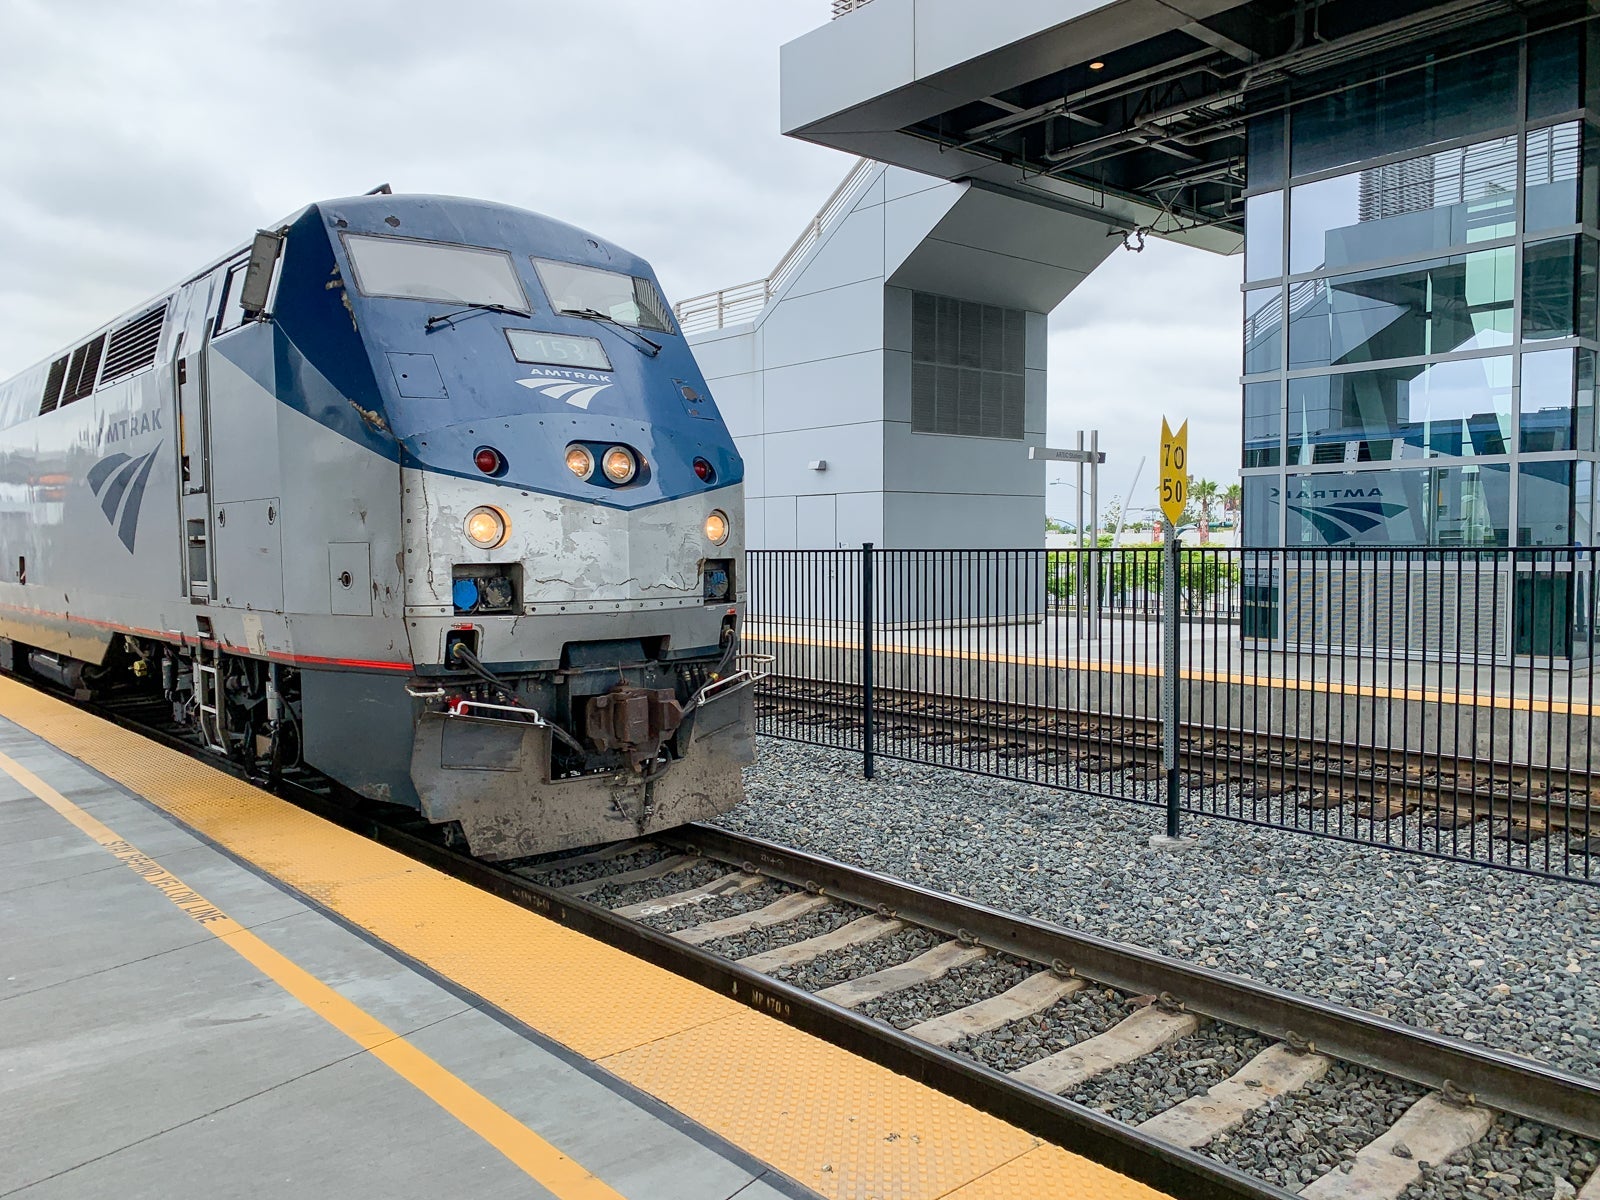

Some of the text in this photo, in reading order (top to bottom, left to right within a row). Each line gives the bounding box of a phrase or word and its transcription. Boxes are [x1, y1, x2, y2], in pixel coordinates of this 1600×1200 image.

[535, 339, 584, 361] 153
[530, 368, 612, 383] AMTRAK
[1164, 444, 1185, 470] 70
[1163, 478, 1183, 503] 50
[101, 840, 227, 924] STAY BEHIND YELLOW LINE
